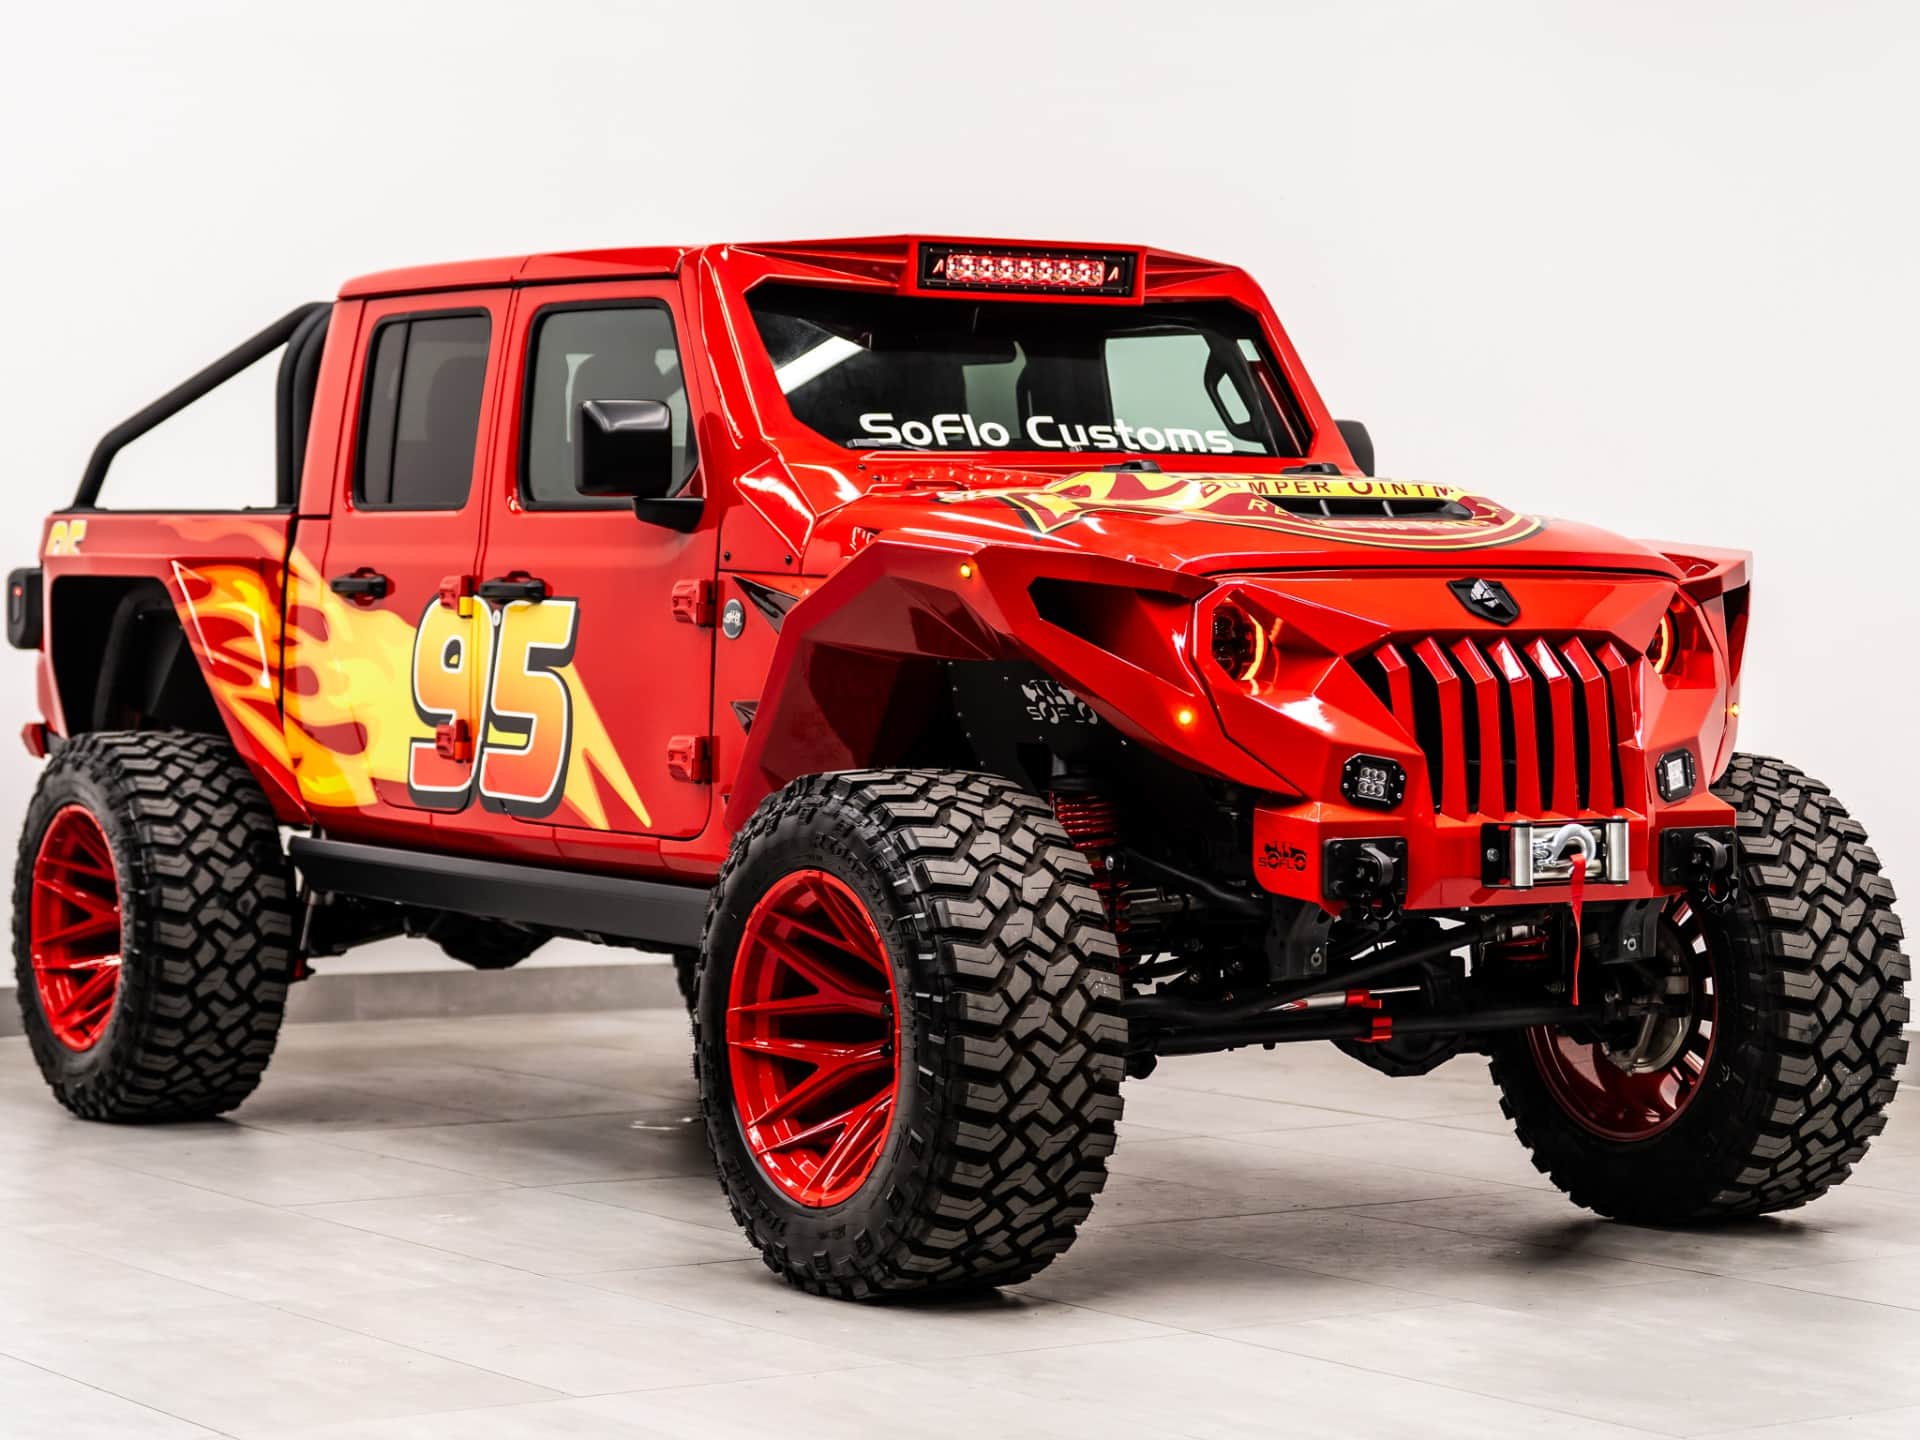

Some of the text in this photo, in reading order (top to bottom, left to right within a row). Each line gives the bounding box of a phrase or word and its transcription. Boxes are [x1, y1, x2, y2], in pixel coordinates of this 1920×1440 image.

[859, 412, 1235, 454] SoFlo Customs
[408, 593, 581, 819] 95
